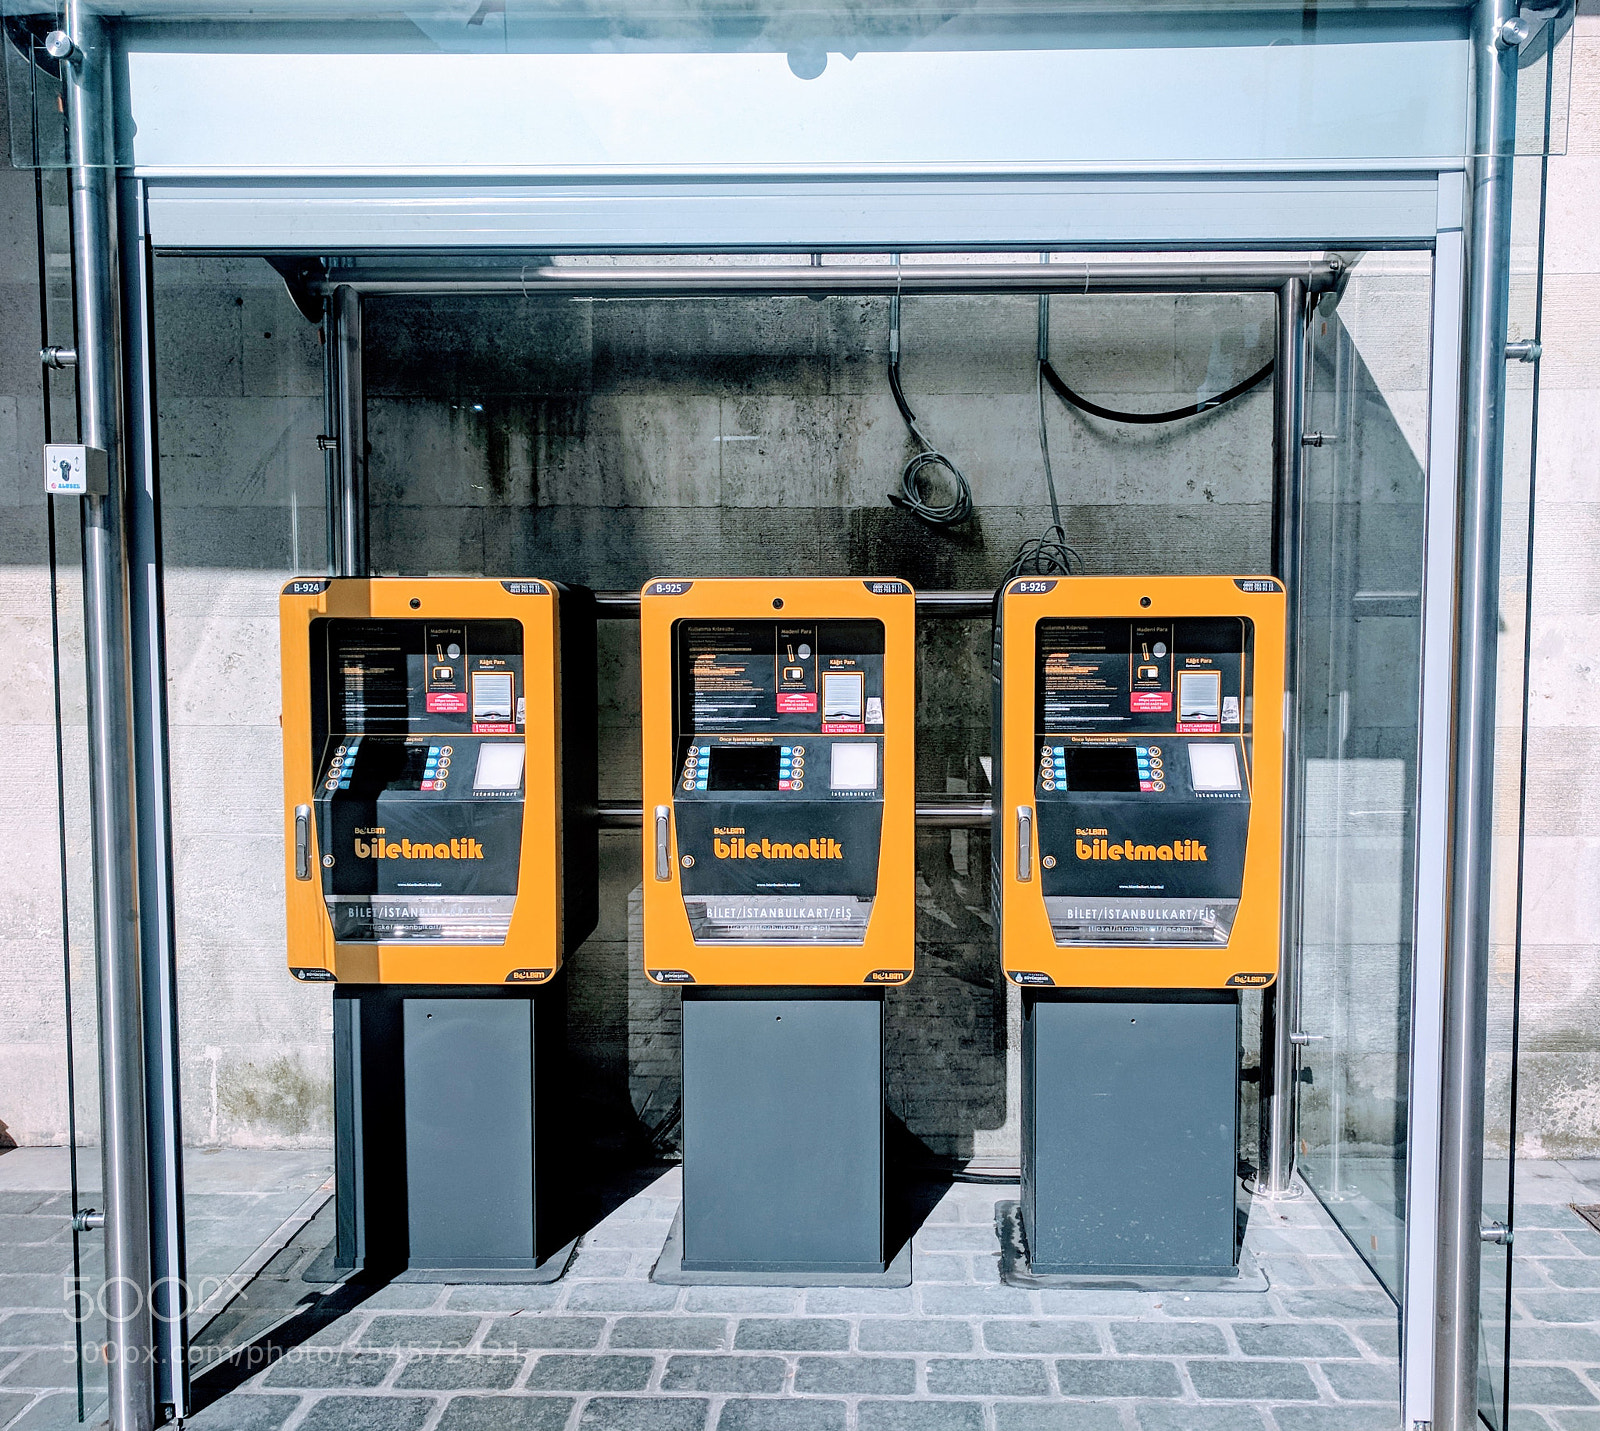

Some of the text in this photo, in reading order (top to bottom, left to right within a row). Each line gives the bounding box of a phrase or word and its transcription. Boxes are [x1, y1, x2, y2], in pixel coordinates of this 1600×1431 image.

[294, 583, 320, 593] B-924
[656, 584, 682, 593] B-925
[1020, 582, 1046, 592] B-926
[354, 837, 484, 860] biletmatik
[713, 837, 843, 860] biletmatik
[1075, 838, 1208, 862] biletmatik
[706, 907, 852, 920] BİLET/İSTANBULKART/FİŞ
[1067, 908, 1216, 921] BİLET/İSTANBULKART/FİŞ
